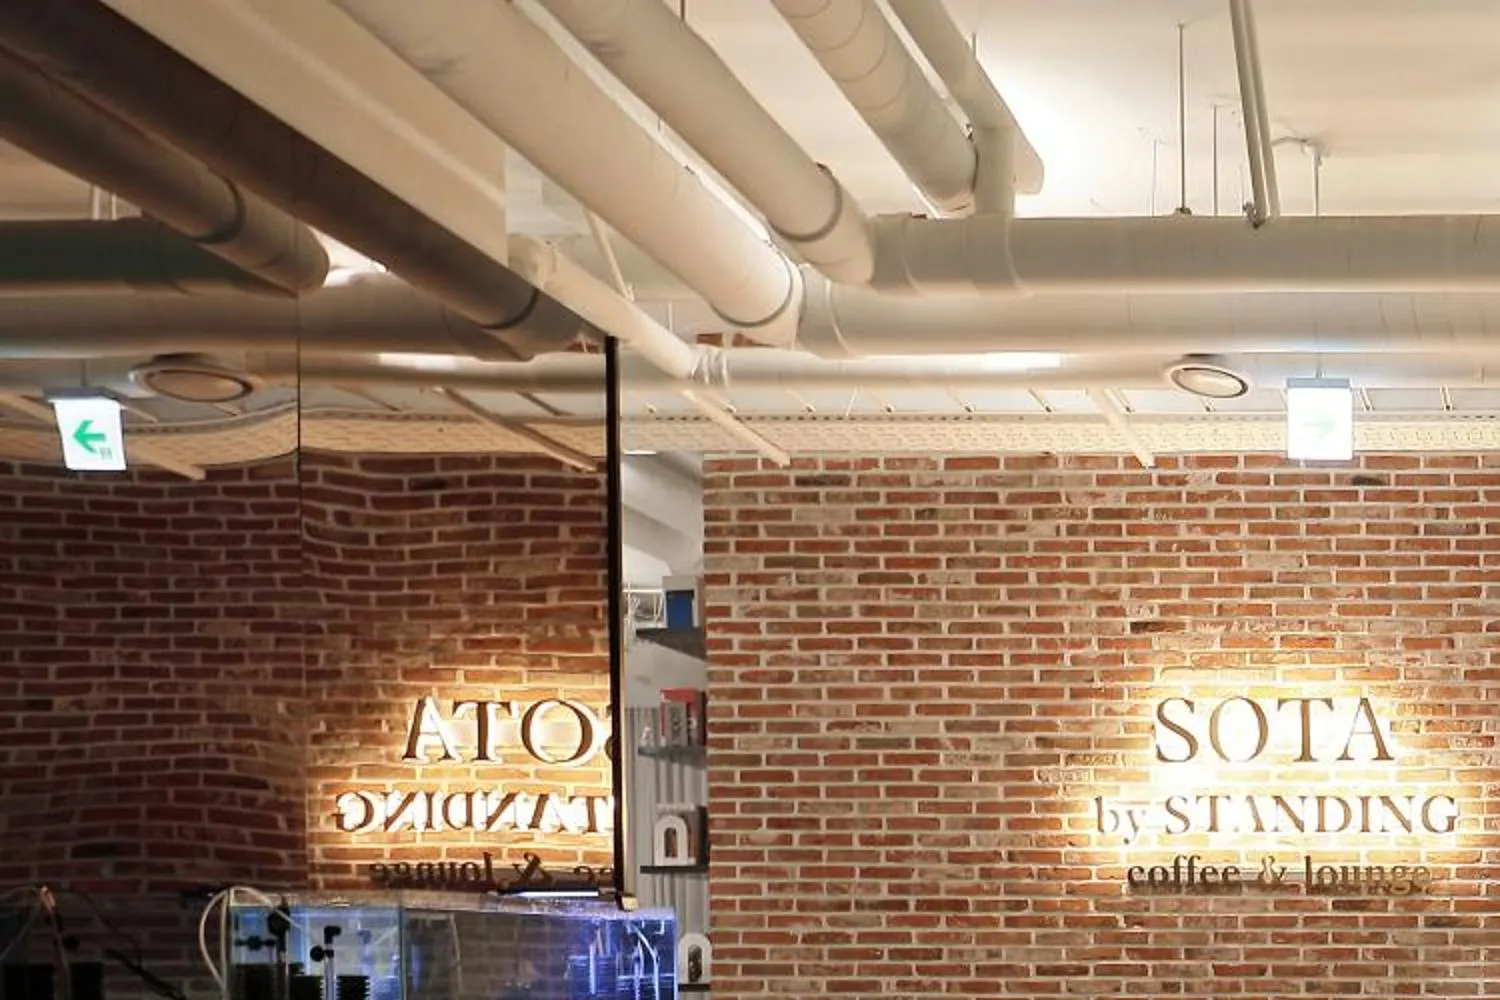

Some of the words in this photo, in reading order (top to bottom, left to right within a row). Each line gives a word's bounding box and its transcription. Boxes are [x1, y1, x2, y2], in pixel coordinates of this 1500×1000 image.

[1155, 696, 1395, 763] SOTA
[1094, 795, 1147, 845] by
[1165, 794, 1458, 835] STANDING
[1127, 854, 1241, 887] coffee
[1257, 855, 1287, 891] &
[1304, 855, 1432, 895] lounge
